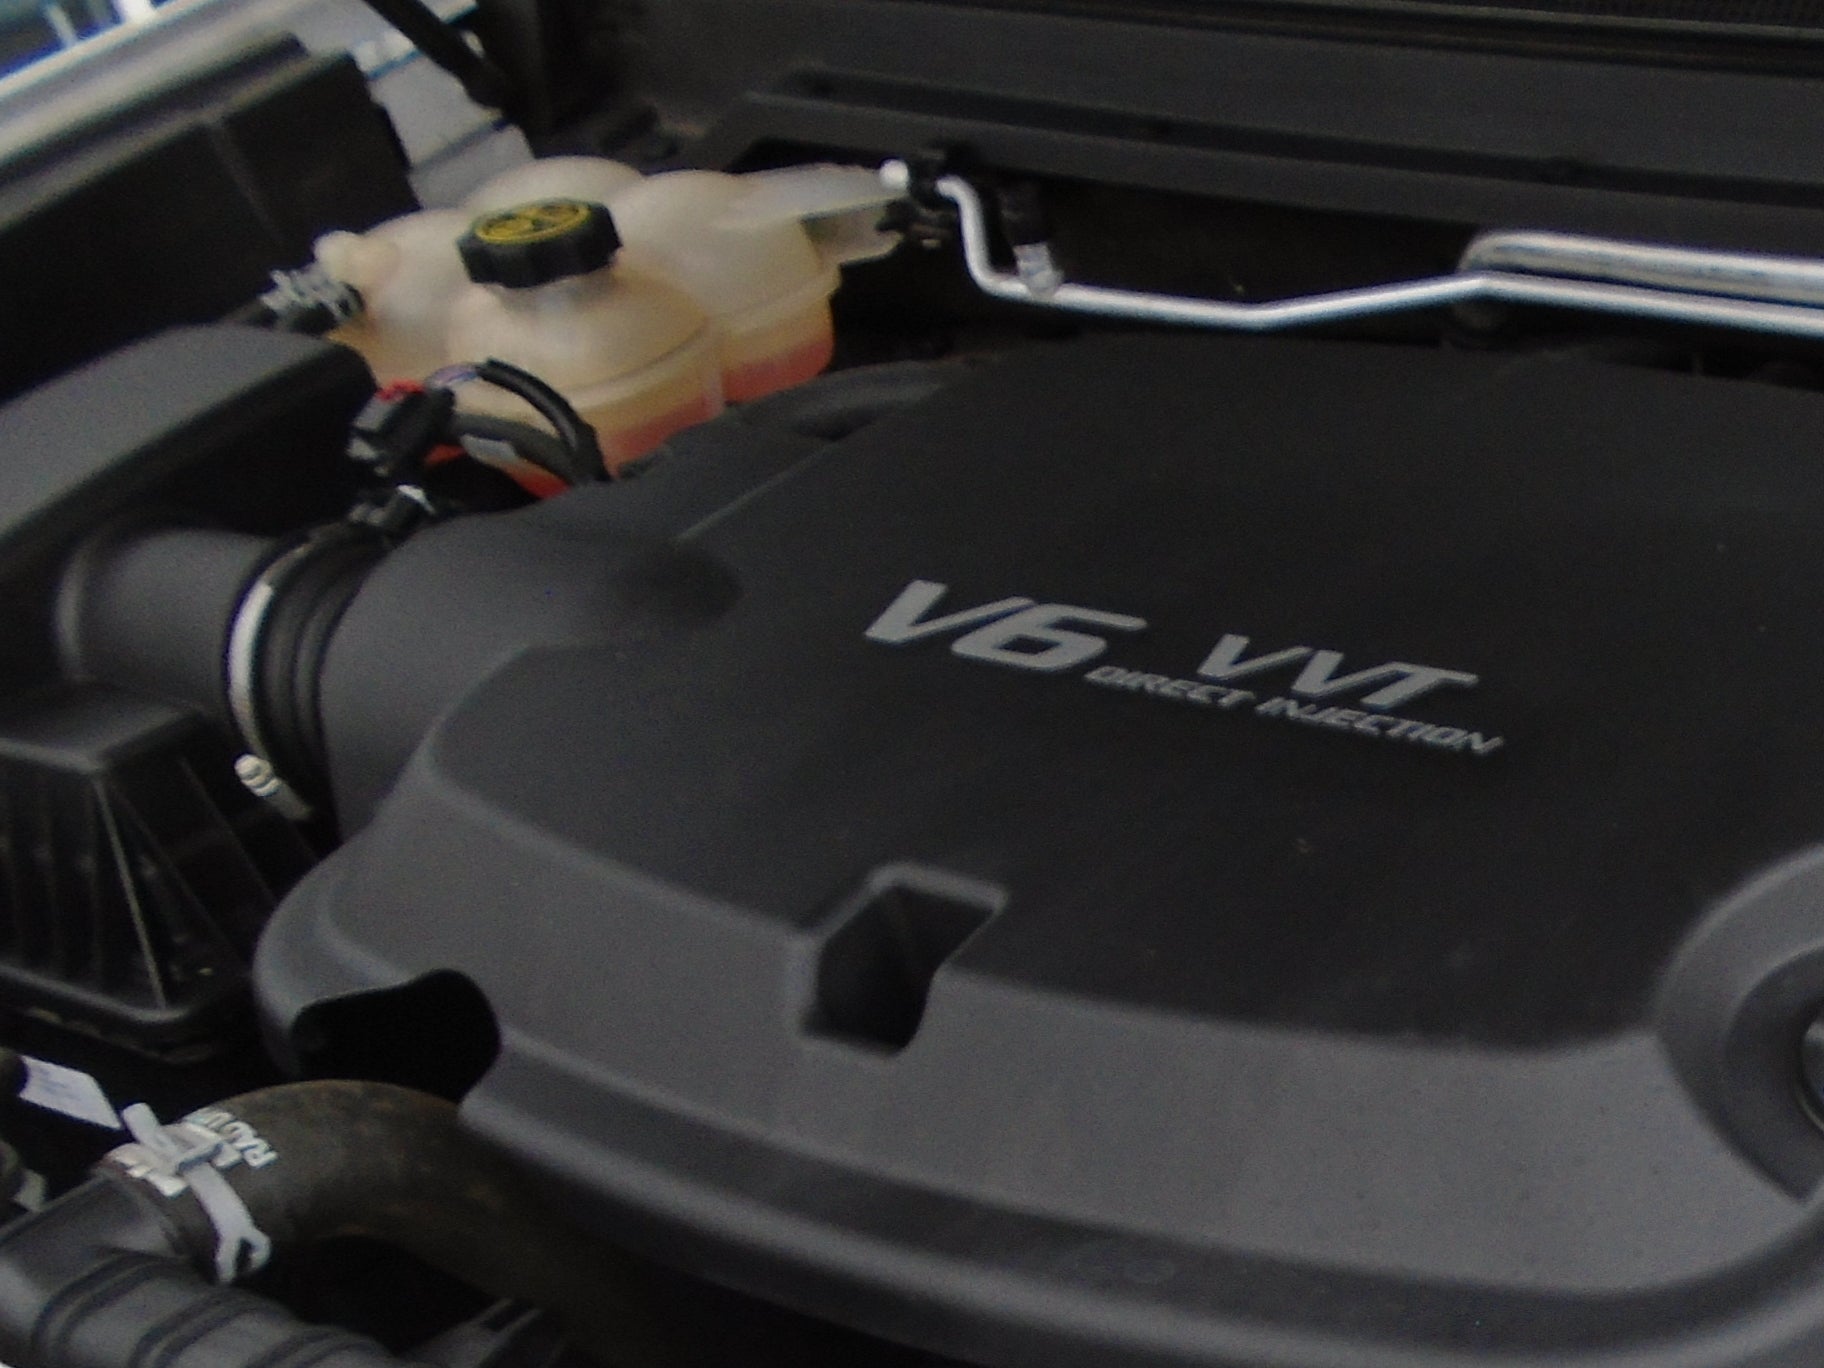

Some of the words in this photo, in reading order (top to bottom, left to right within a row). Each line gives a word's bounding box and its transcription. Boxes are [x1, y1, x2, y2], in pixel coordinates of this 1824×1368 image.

[865, 579, 1147, 671] V6
[1197, 634, 1479, 709] VVT
[1084, 665, 1255, 709] DIRECT
[1255, 696, 1504, 755] INJECTION
